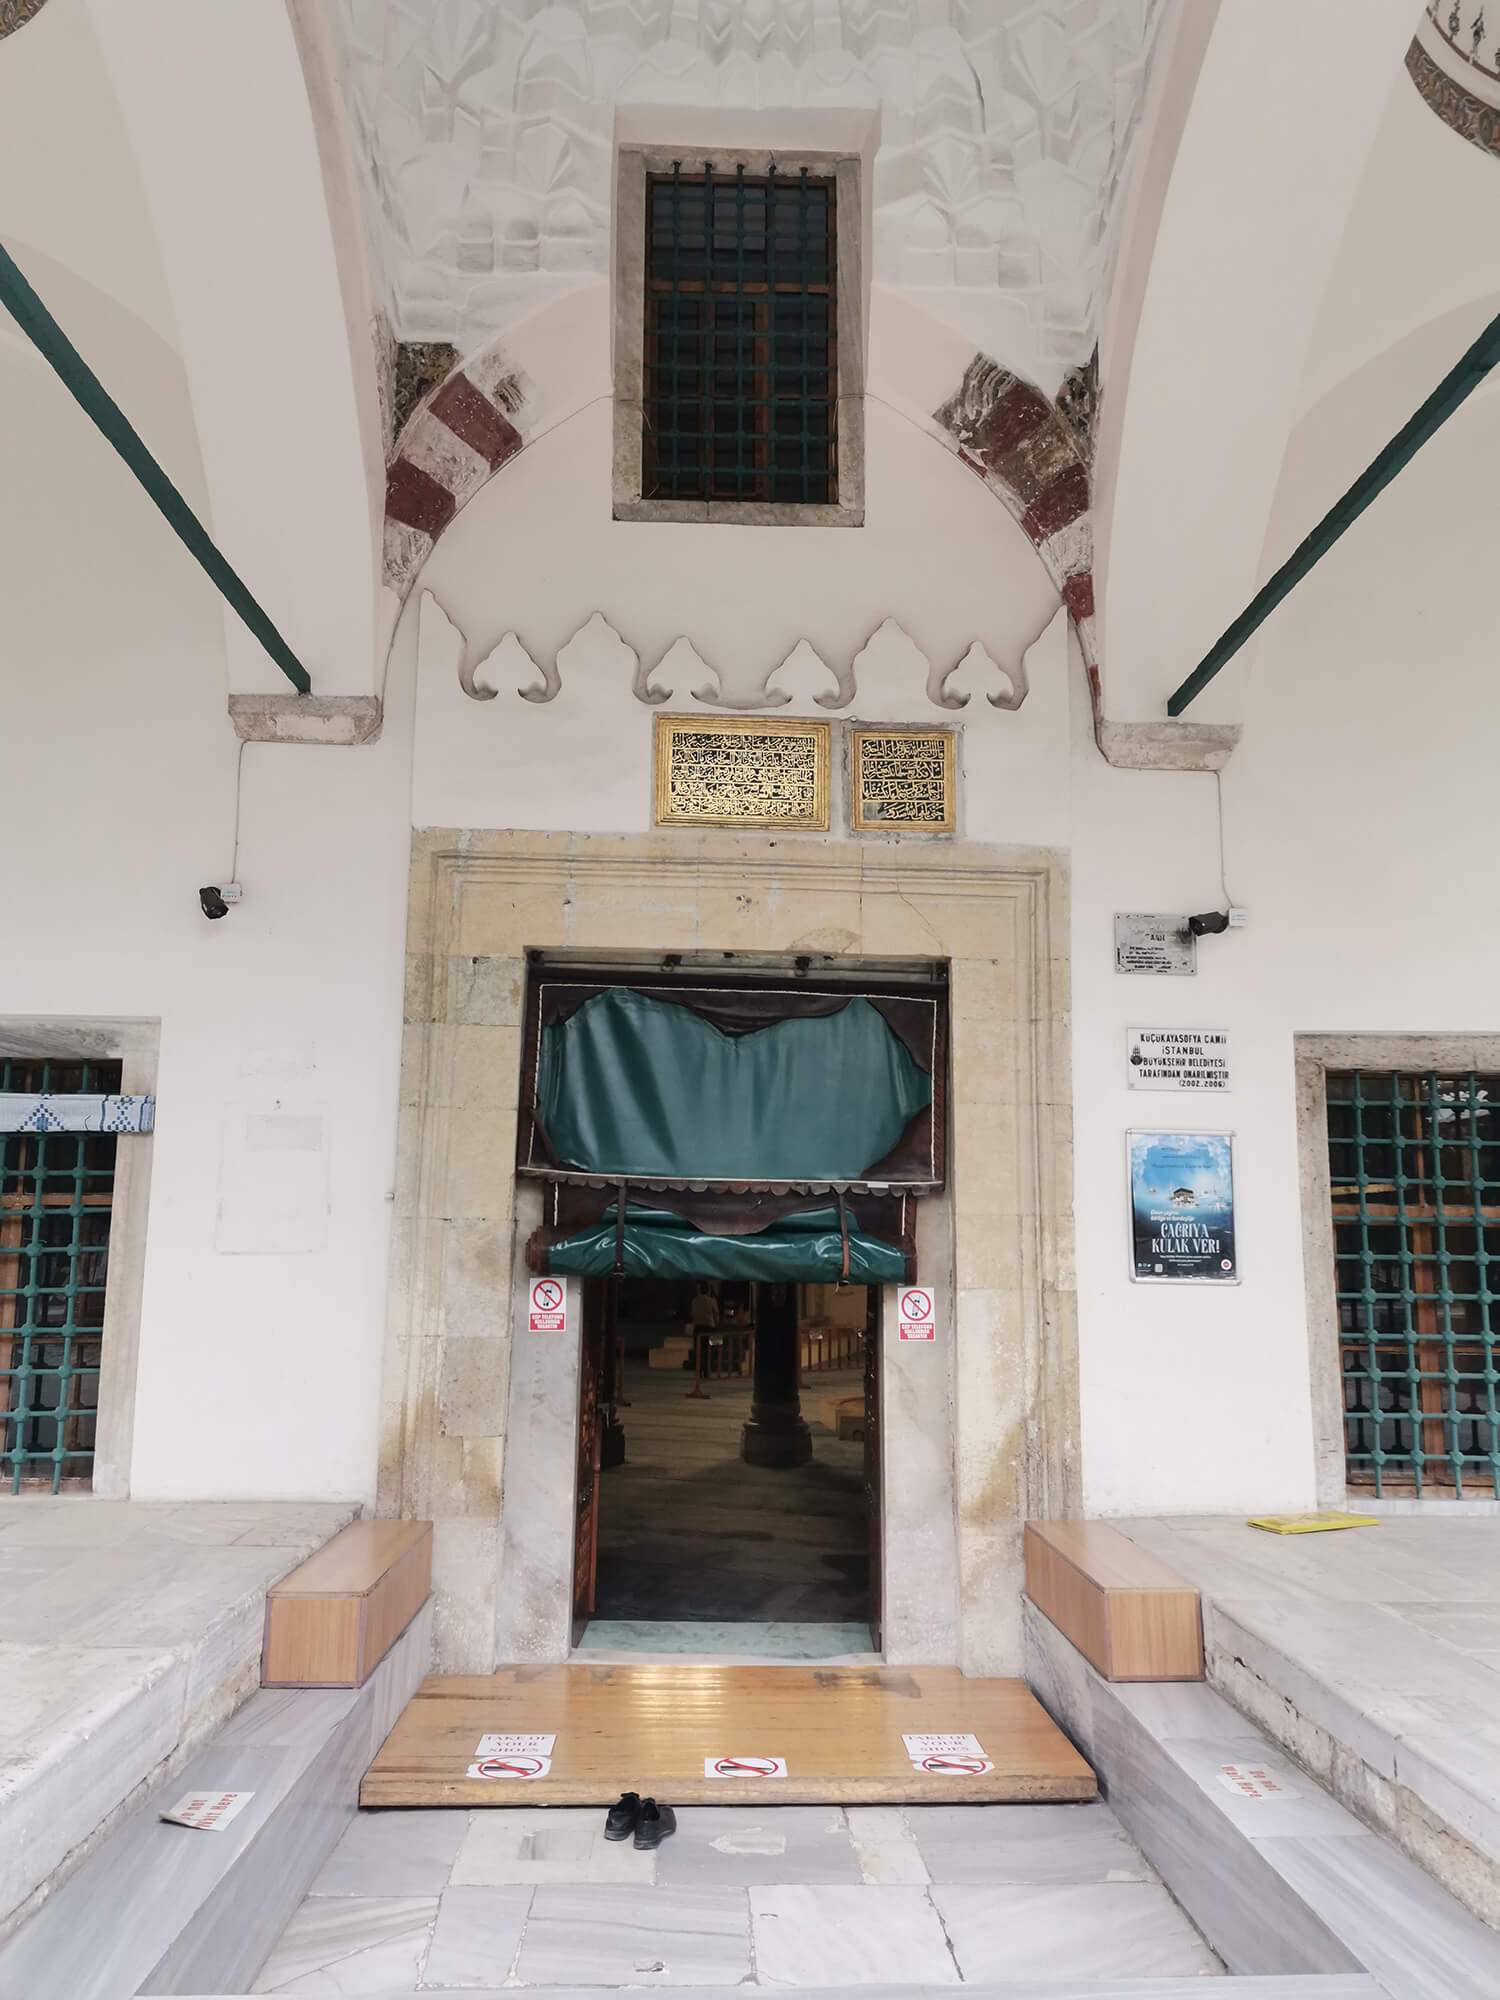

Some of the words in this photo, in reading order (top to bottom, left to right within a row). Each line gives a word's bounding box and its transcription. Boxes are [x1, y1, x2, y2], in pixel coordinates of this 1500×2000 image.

[1139, 1069, 1181, 1078] TARAFINDAN
[1152, 1239, 1190, 1253] KULAK
[1192, 1240, 1220, 1253] VER!
